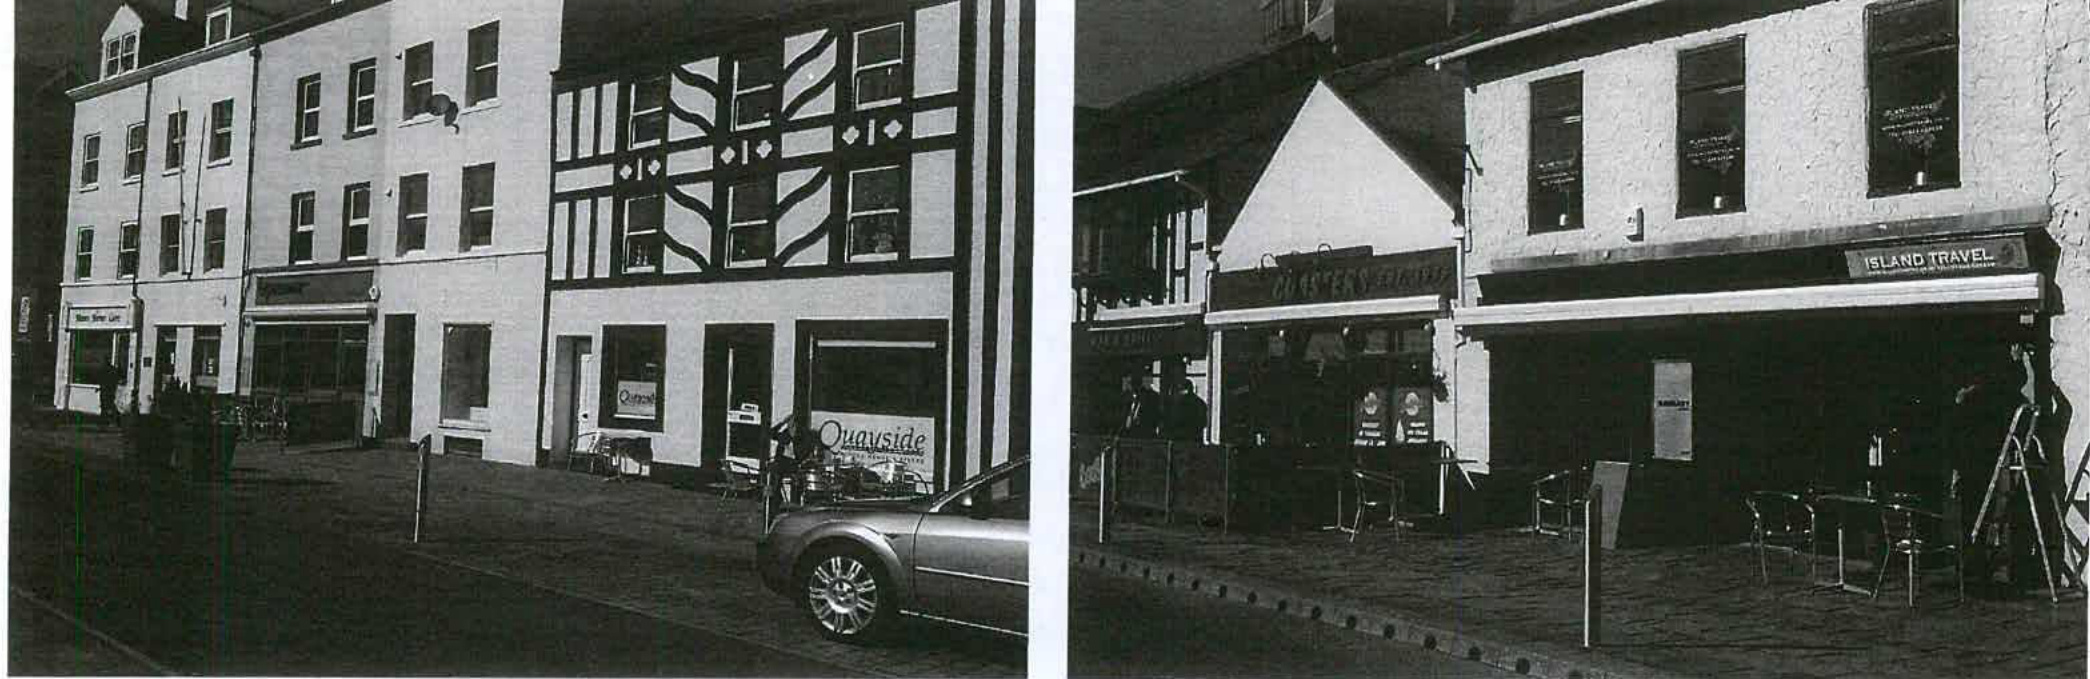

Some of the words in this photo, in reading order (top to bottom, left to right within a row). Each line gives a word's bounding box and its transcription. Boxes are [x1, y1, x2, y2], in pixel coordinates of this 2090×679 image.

[1865, 252, 1924, 270] ISLAND
[1928, 247, 1994, 265] TRAVEL
[819, 419, 926, 454] Quayside
